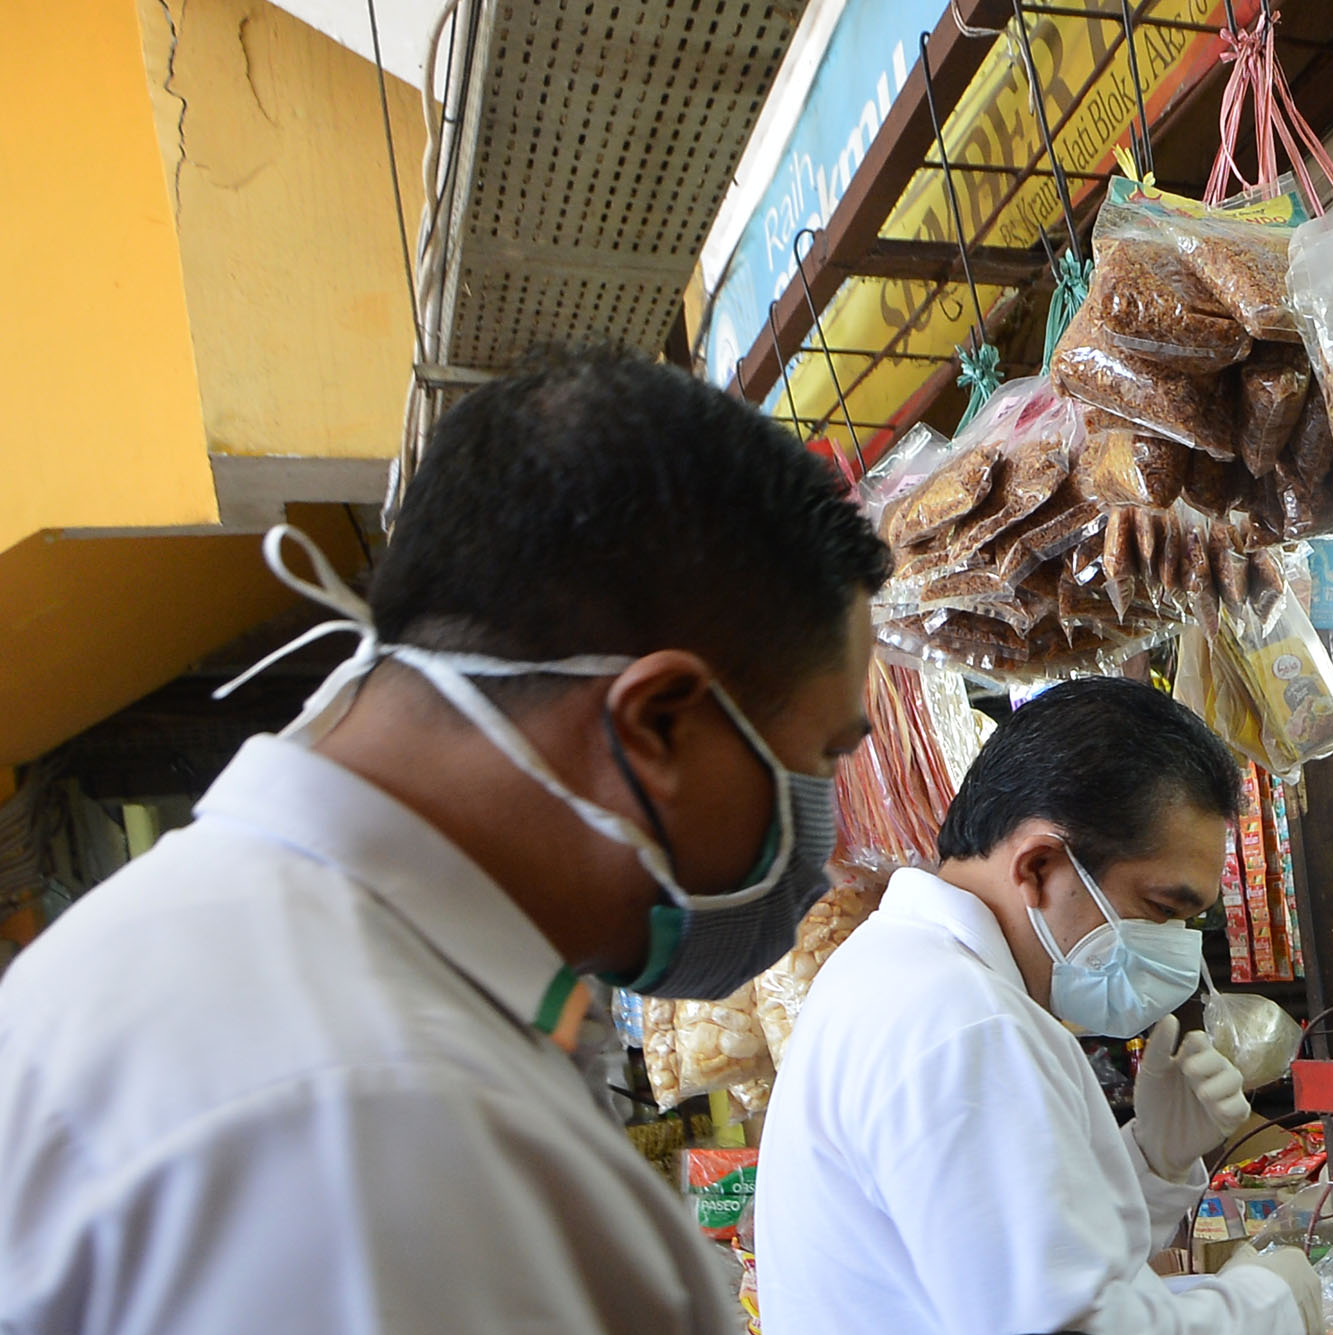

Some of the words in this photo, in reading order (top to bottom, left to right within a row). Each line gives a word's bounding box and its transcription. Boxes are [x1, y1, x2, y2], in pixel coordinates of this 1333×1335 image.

[764, 150, 817, 272] Raih
[1019, 155, 1065, 238] Kramt
[1063, 115, 1098, 180] Jati
[1087, 72, 1136, 143] Blok
